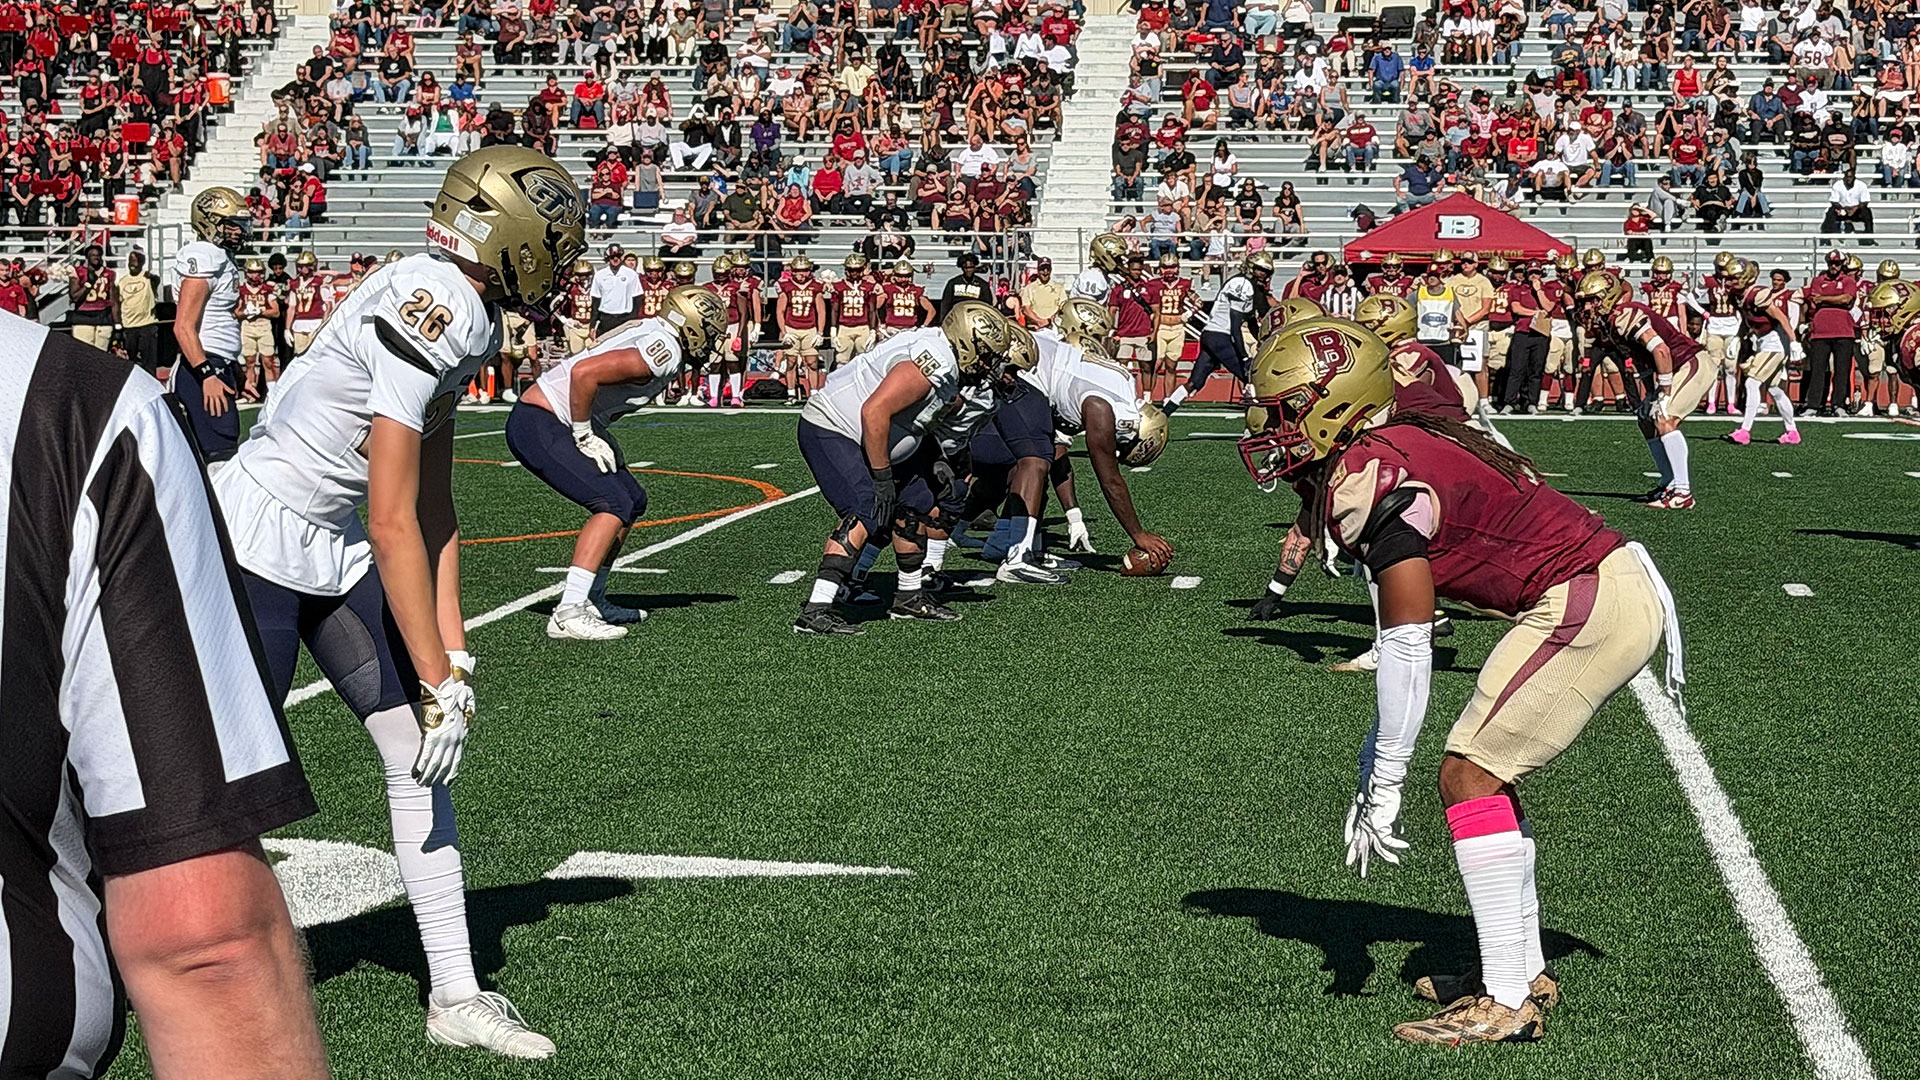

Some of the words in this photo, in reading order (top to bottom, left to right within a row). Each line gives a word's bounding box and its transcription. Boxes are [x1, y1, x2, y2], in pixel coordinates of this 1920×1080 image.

[1804, 51, 1822, 66] 58
[1436, 214, 1482, 239] B
[399, 288, 454, 342] 26
[646, 339, 673, 367] 80
[1303, 328, 1354, 374] B
